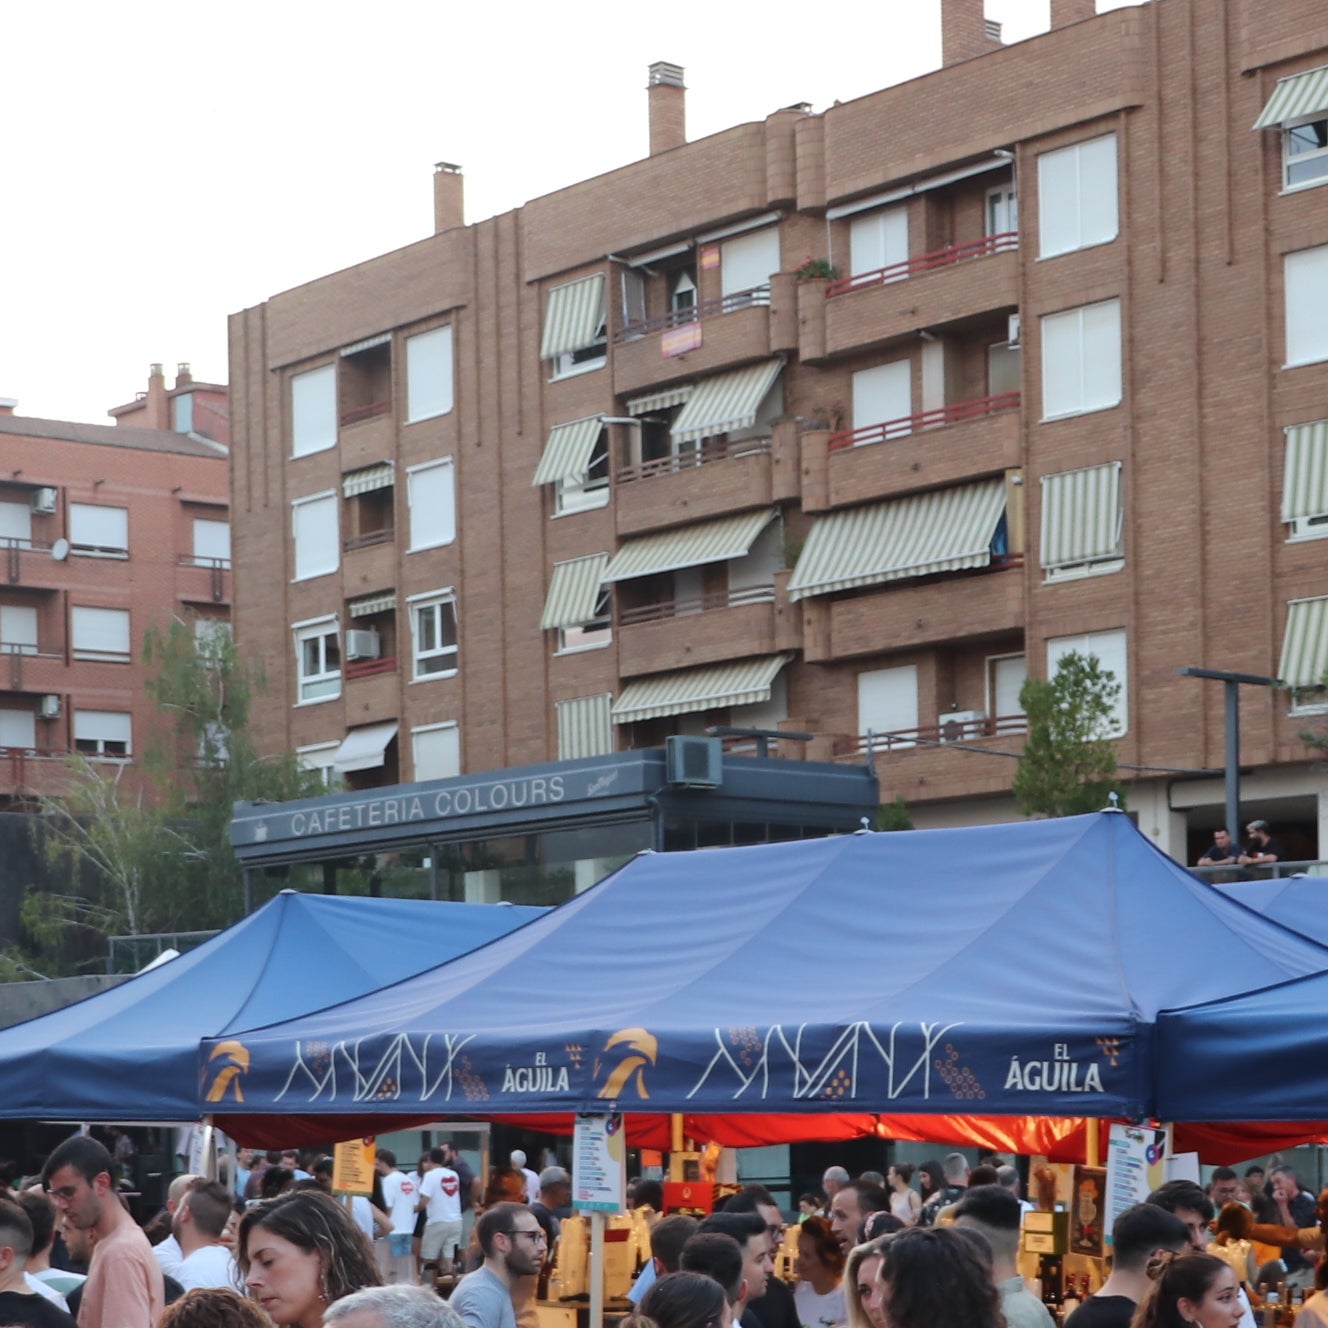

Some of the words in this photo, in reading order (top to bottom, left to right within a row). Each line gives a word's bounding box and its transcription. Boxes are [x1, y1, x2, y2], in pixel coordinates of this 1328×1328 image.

[290, 798, 424, 838] CAFETERIA
[435, 776, 566, 817] COLOURS
[535, 1051, 548, 1066] EL
[1054, 1043, 1071, 1060] EL
[501, 1063, 570, 1093] ÁGUILA
[1003, 1055, 1105, 1093] ÁGUILA
